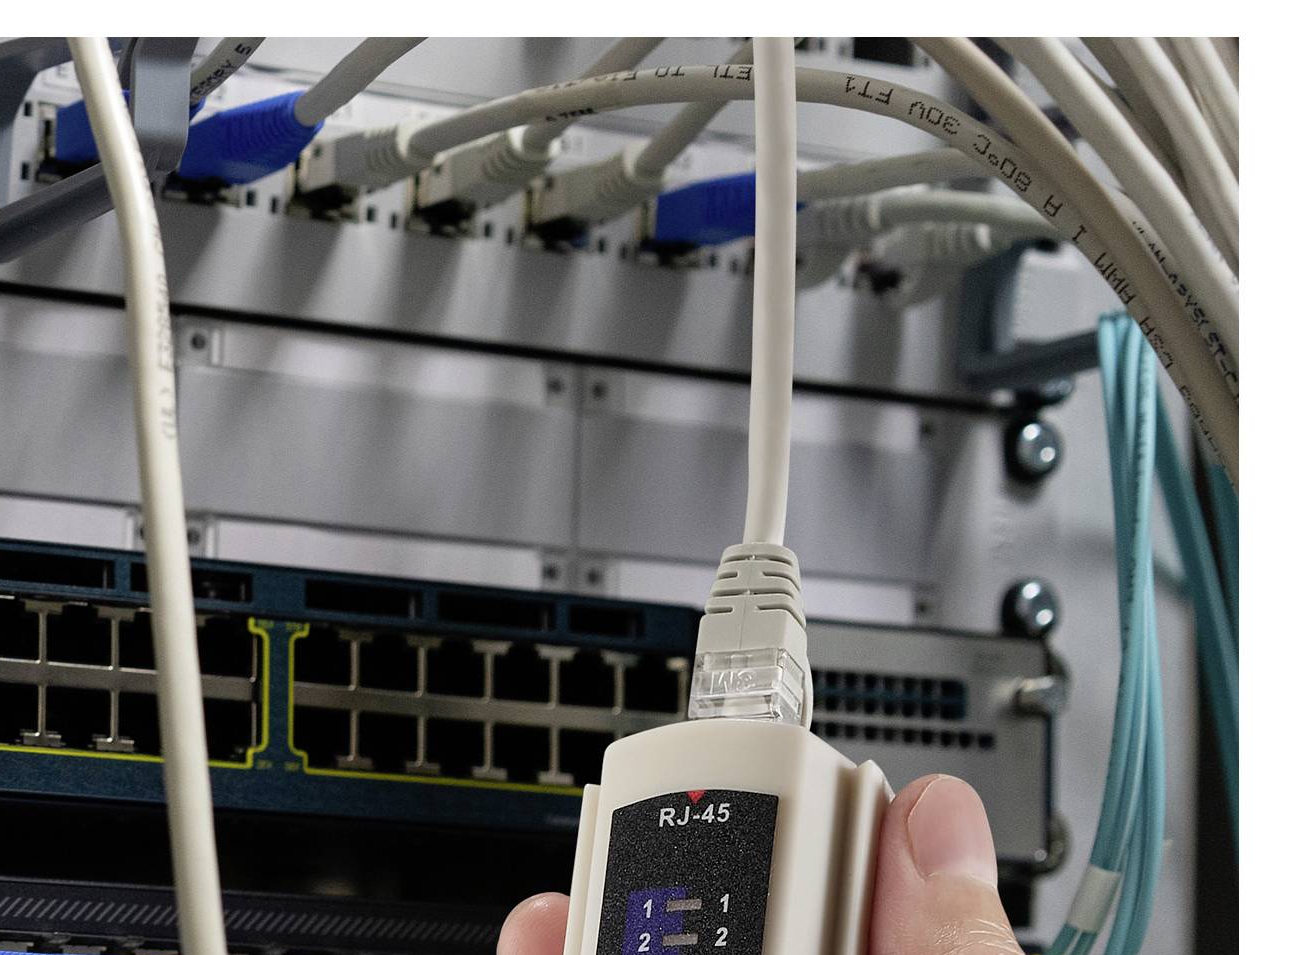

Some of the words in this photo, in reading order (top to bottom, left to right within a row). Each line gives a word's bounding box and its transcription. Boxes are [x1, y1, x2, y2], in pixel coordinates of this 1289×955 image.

[844, 75, 894, 106] FT1
[909, 101, 960, 137] 30V
[659, 802, 730, 828] RJ-45
[643, 899, 653, 919] 1
[720, 893, 730, 913] 1
[637, 932, 651, 952] 2
[714, 927, 728, 947] 2
